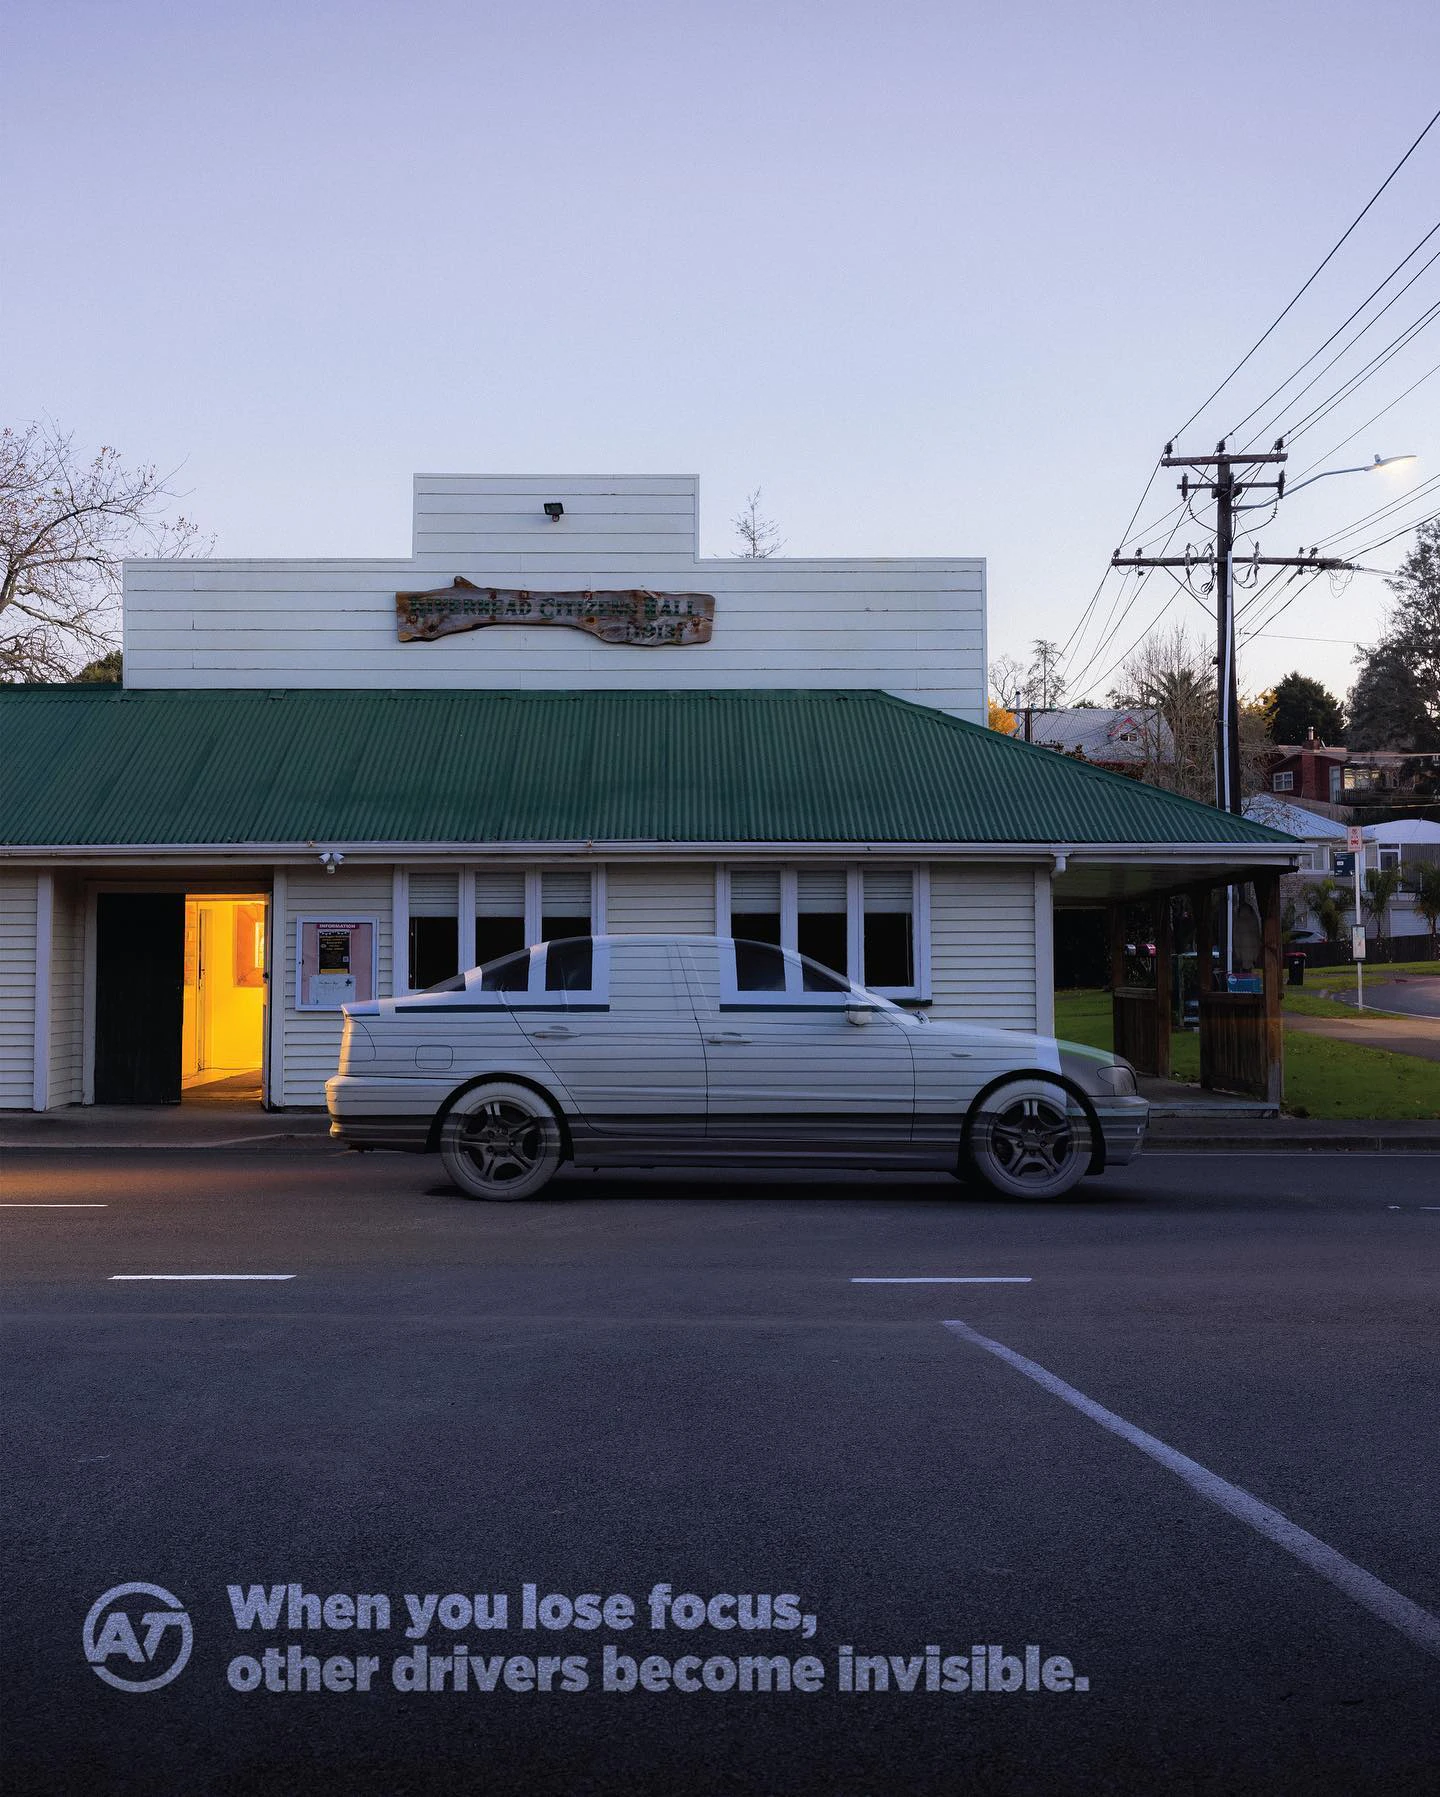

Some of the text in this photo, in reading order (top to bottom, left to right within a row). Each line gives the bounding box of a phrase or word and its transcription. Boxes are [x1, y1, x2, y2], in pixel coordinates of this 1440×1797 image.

[409, 596, 701, 619] RIVERHEAD CITIZENS HALL
